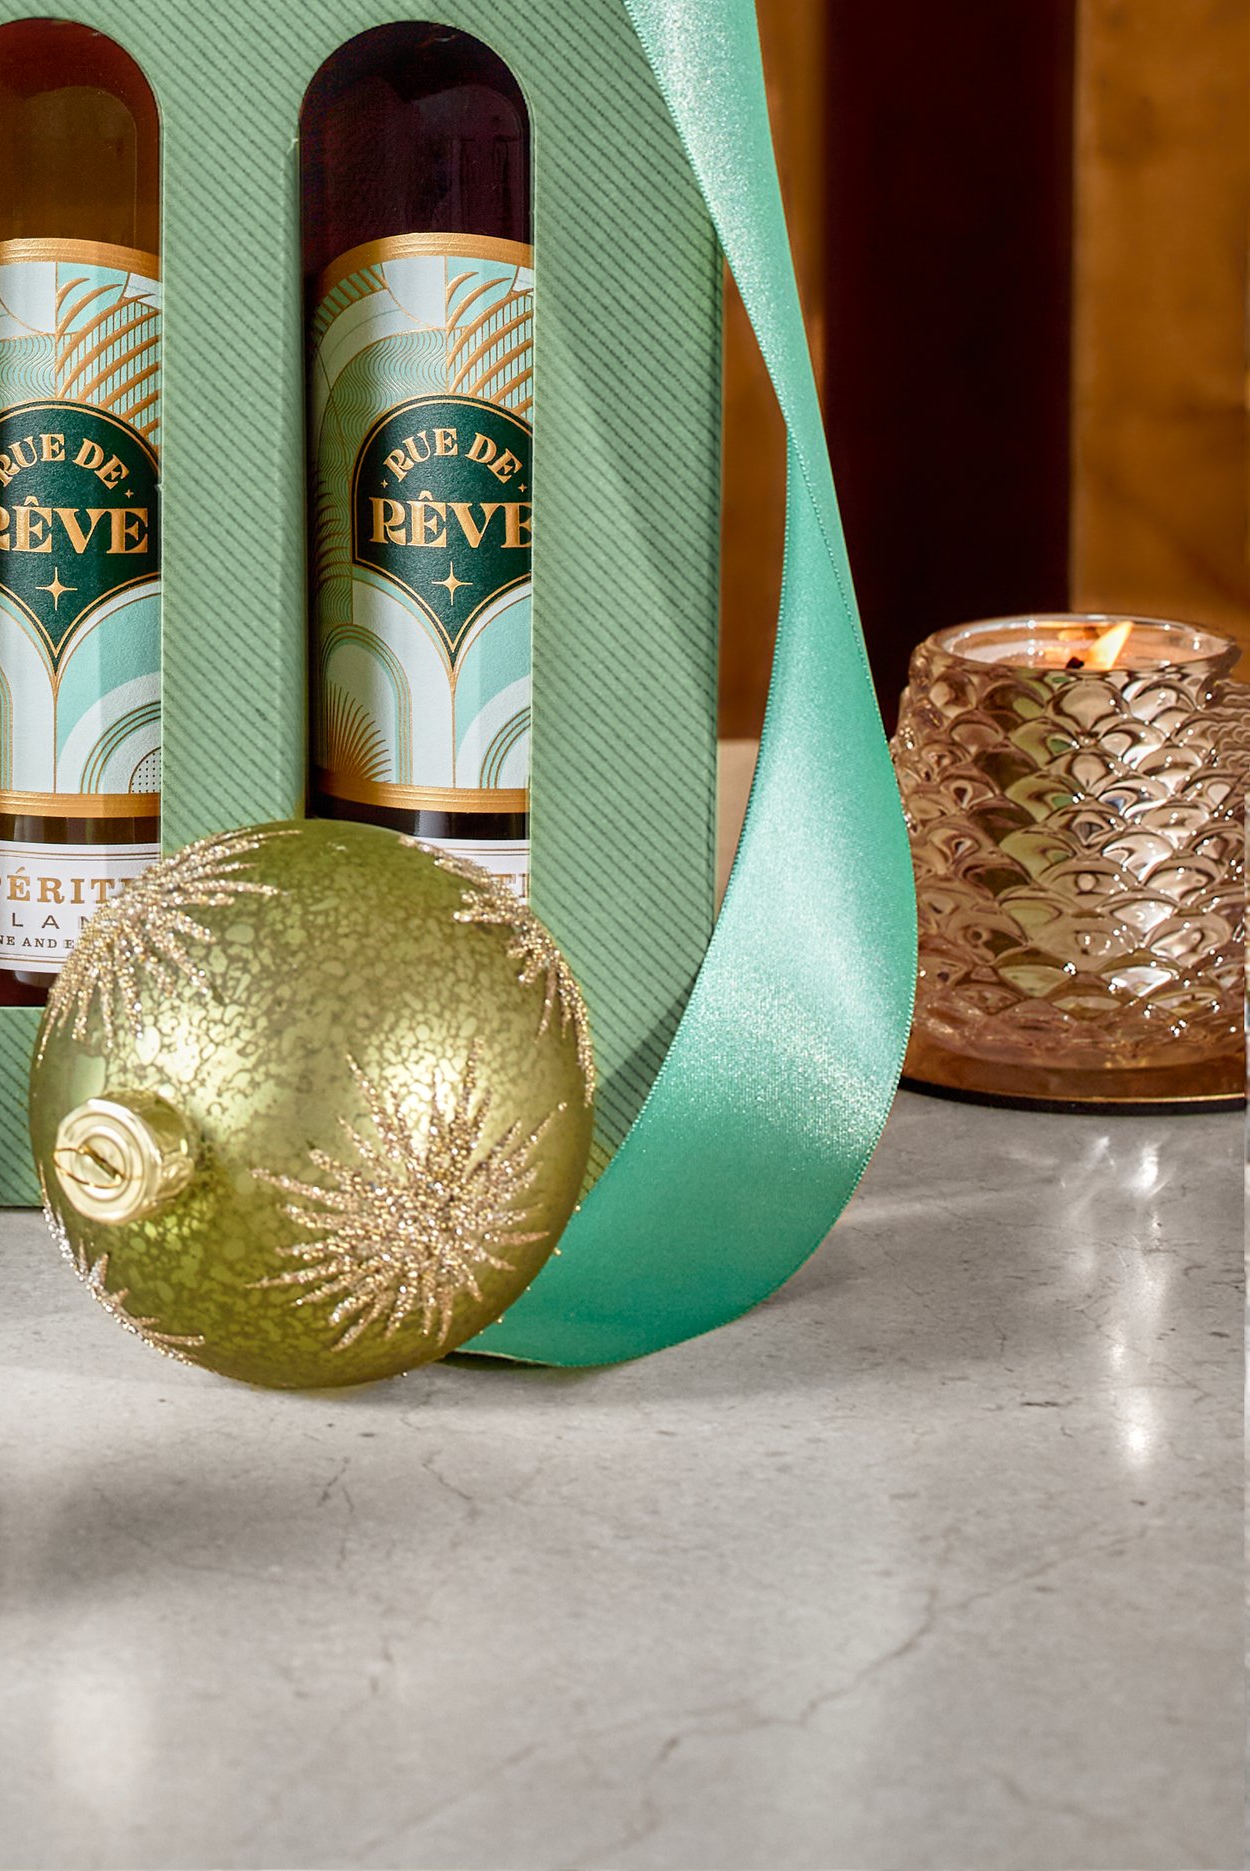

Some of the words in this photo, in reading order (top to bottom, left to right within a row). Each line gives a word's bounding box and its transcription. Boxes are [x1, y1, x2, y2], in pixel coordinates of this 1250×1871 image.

[72, 437, 130, 490] DE
[382, 428, 459, 482] RUE
[464, 432, 524, 484] DE
[21, 937, 58, 949] AND
